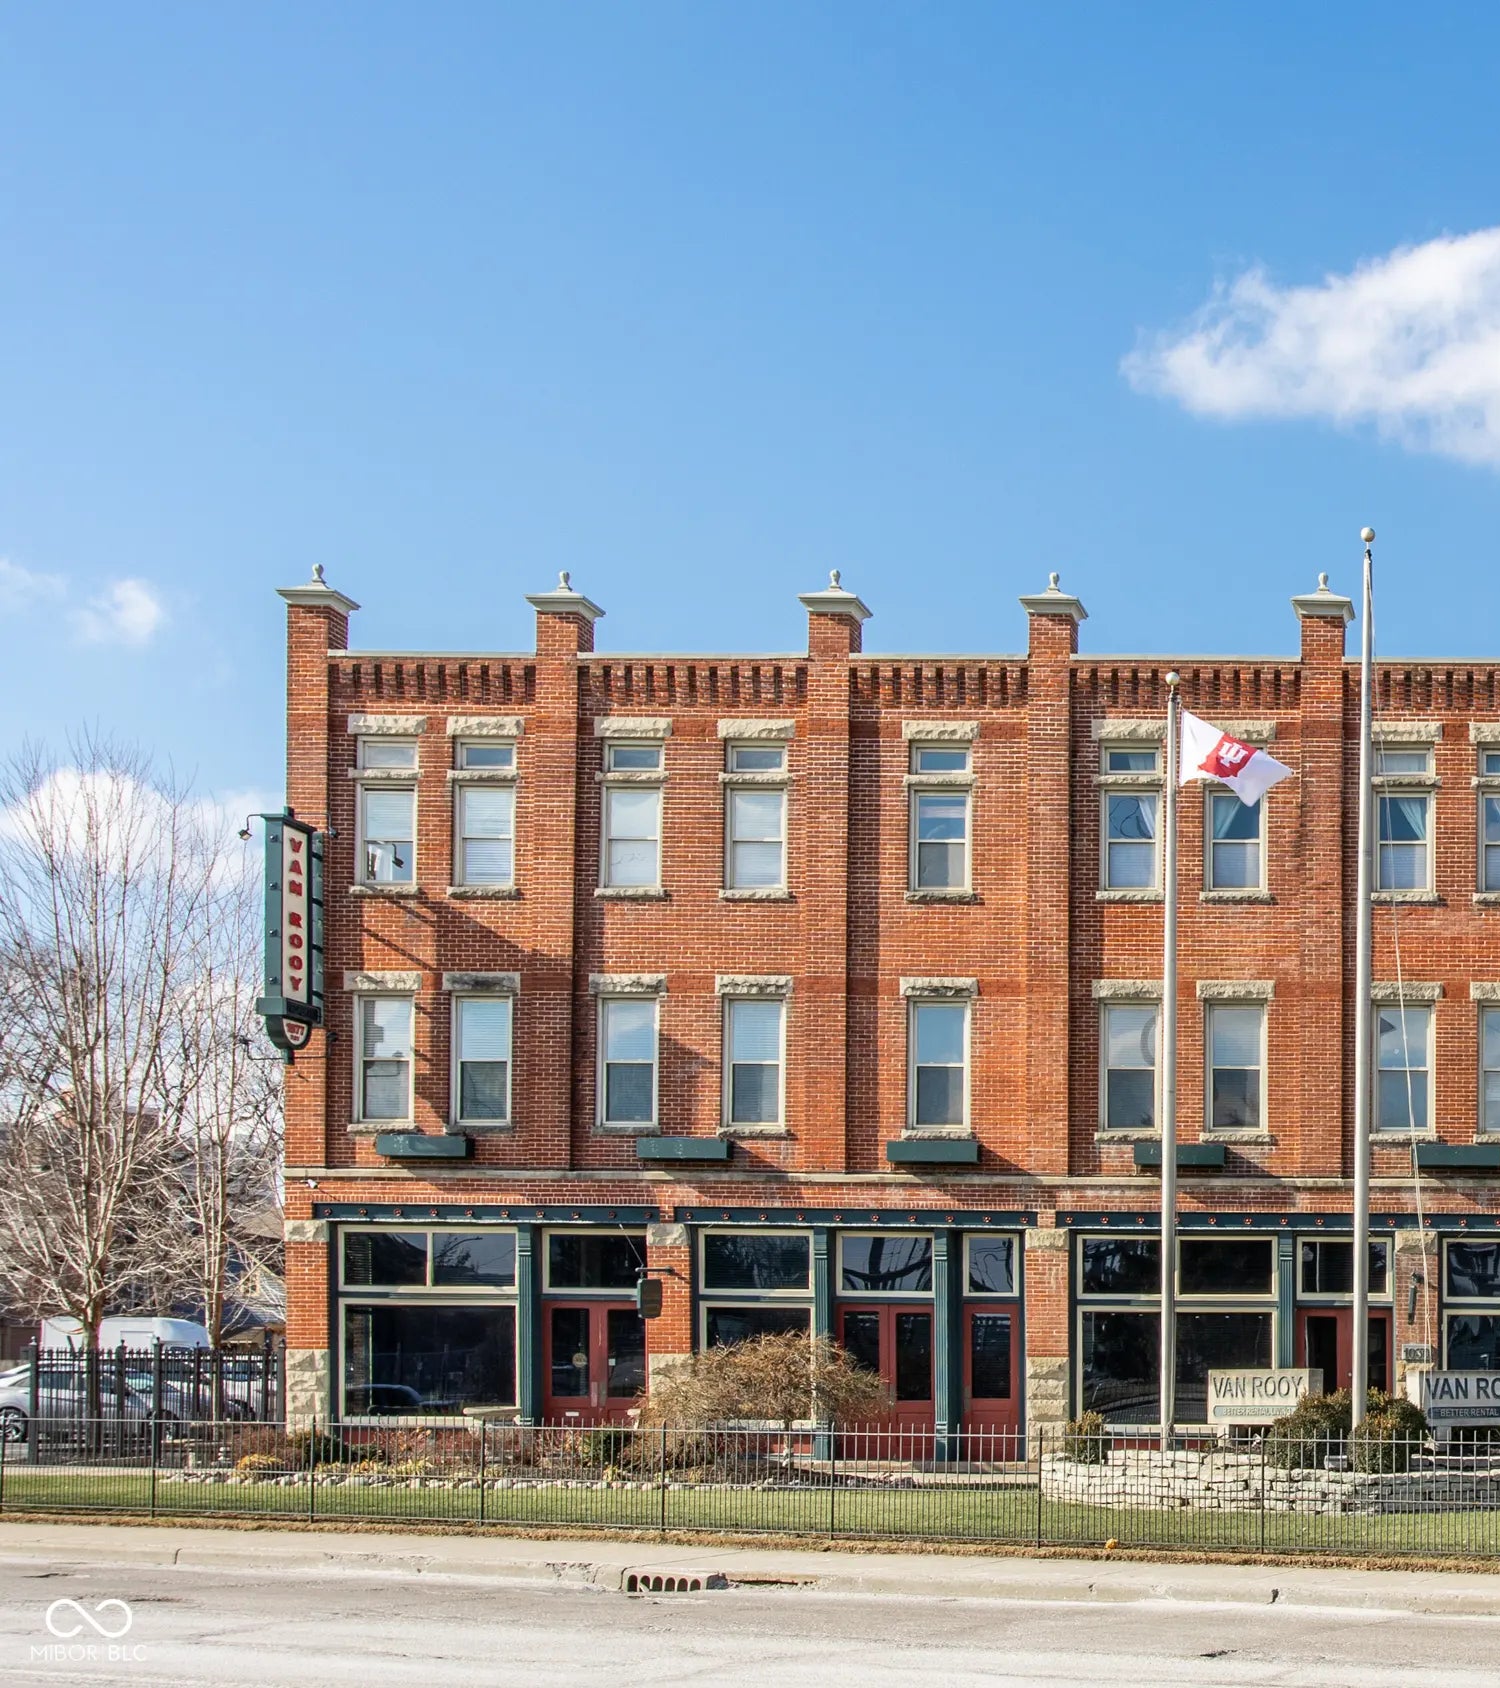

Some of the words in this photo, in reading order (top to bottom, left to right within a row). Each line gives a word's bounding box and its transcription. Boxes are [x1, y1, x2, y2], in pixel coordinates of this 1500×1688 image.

[289, 837, 303, 896] VAN
[289, 911, 303, 992] ROOY
[1213, 1376, 1246, 1398] VAN
[1251, 1376, 1303, 1398] ROOY
[1425, 1377, 1468, 1400] VAN
[1222, 1407, 1247, 1416] BETTER
[1247, 1407, 1271, 1416] RENTAL
[1440, 1408, 1471, 1417] BETTER
[1471, 1407, 1499, 1416] RENTAL
